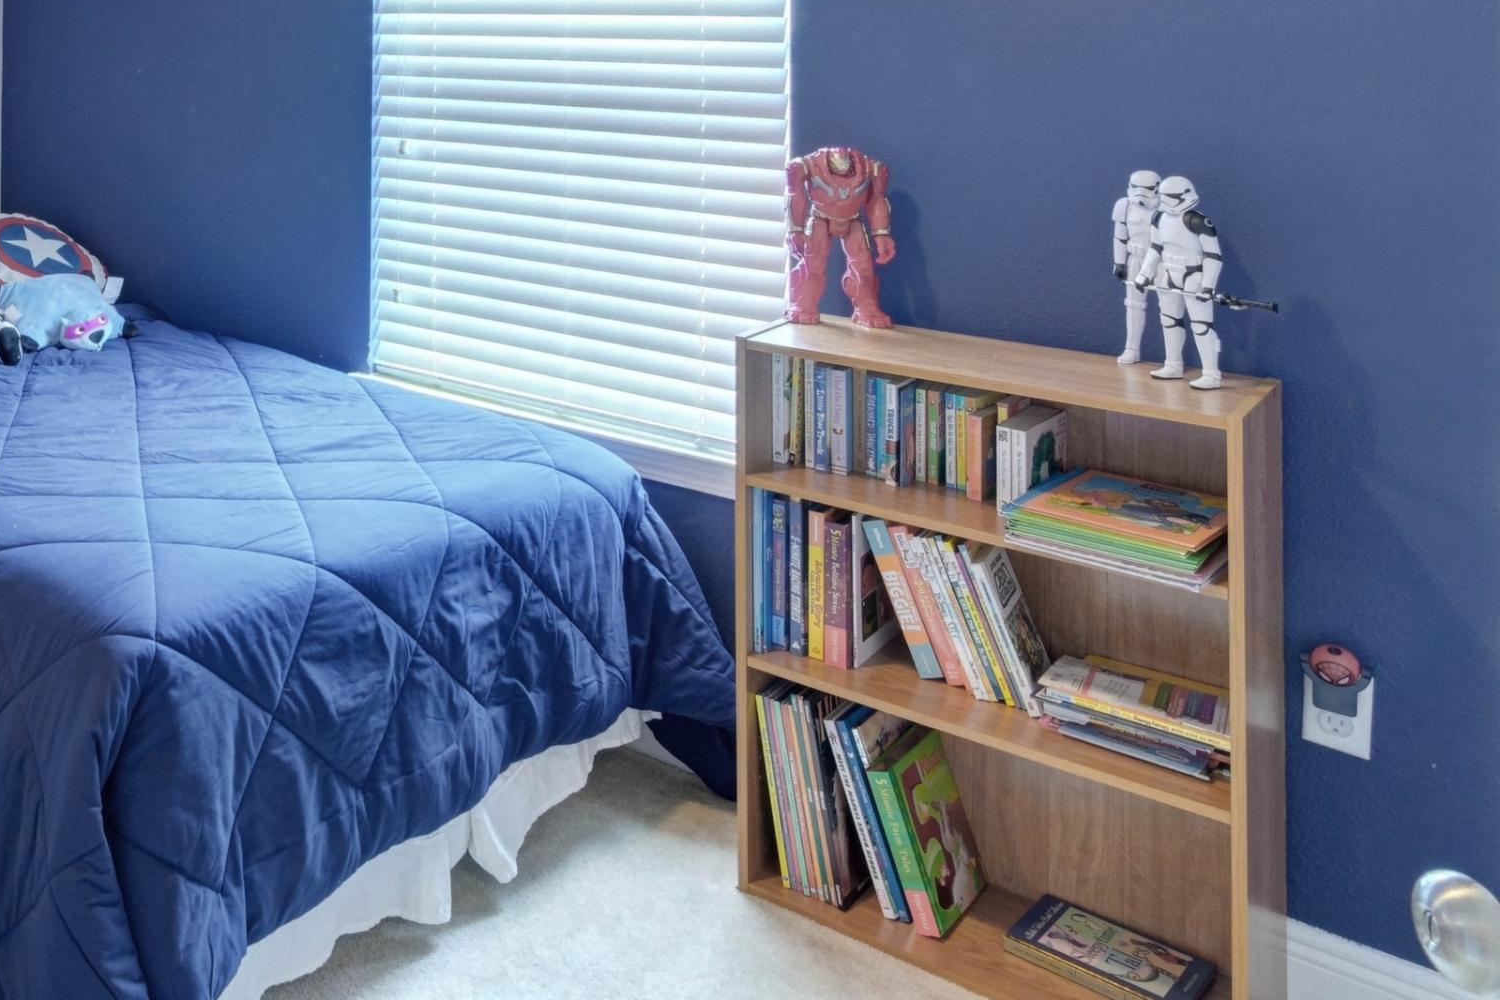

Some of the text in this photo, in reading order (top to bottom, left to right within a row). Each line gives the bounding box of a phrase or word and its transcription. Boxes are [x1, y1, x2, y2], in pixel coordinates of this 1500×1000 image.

[816, 389, 826, 455] Little Blue Truck
[790, 535, 801, 624] 5-MINUTE RACING STORIES
[831, 535, 840, 560] Minute
[831, 562, 840, 590] Bedtime
[814, 604, 822, 627] Story
[831, 592, 841, 615] Stories
[883, 569, 921, 634] BIGGIE!
[834, 751, 846, 773] MEET
[841, 773, 851, 789] THE
[846, 789, 861, 820] MARVEL
[855, 820, 870, 849] SUPER
[864, 849, 880, 881] HEROES
[875, 776, 913, 874] 5 Minute Farm Tales
